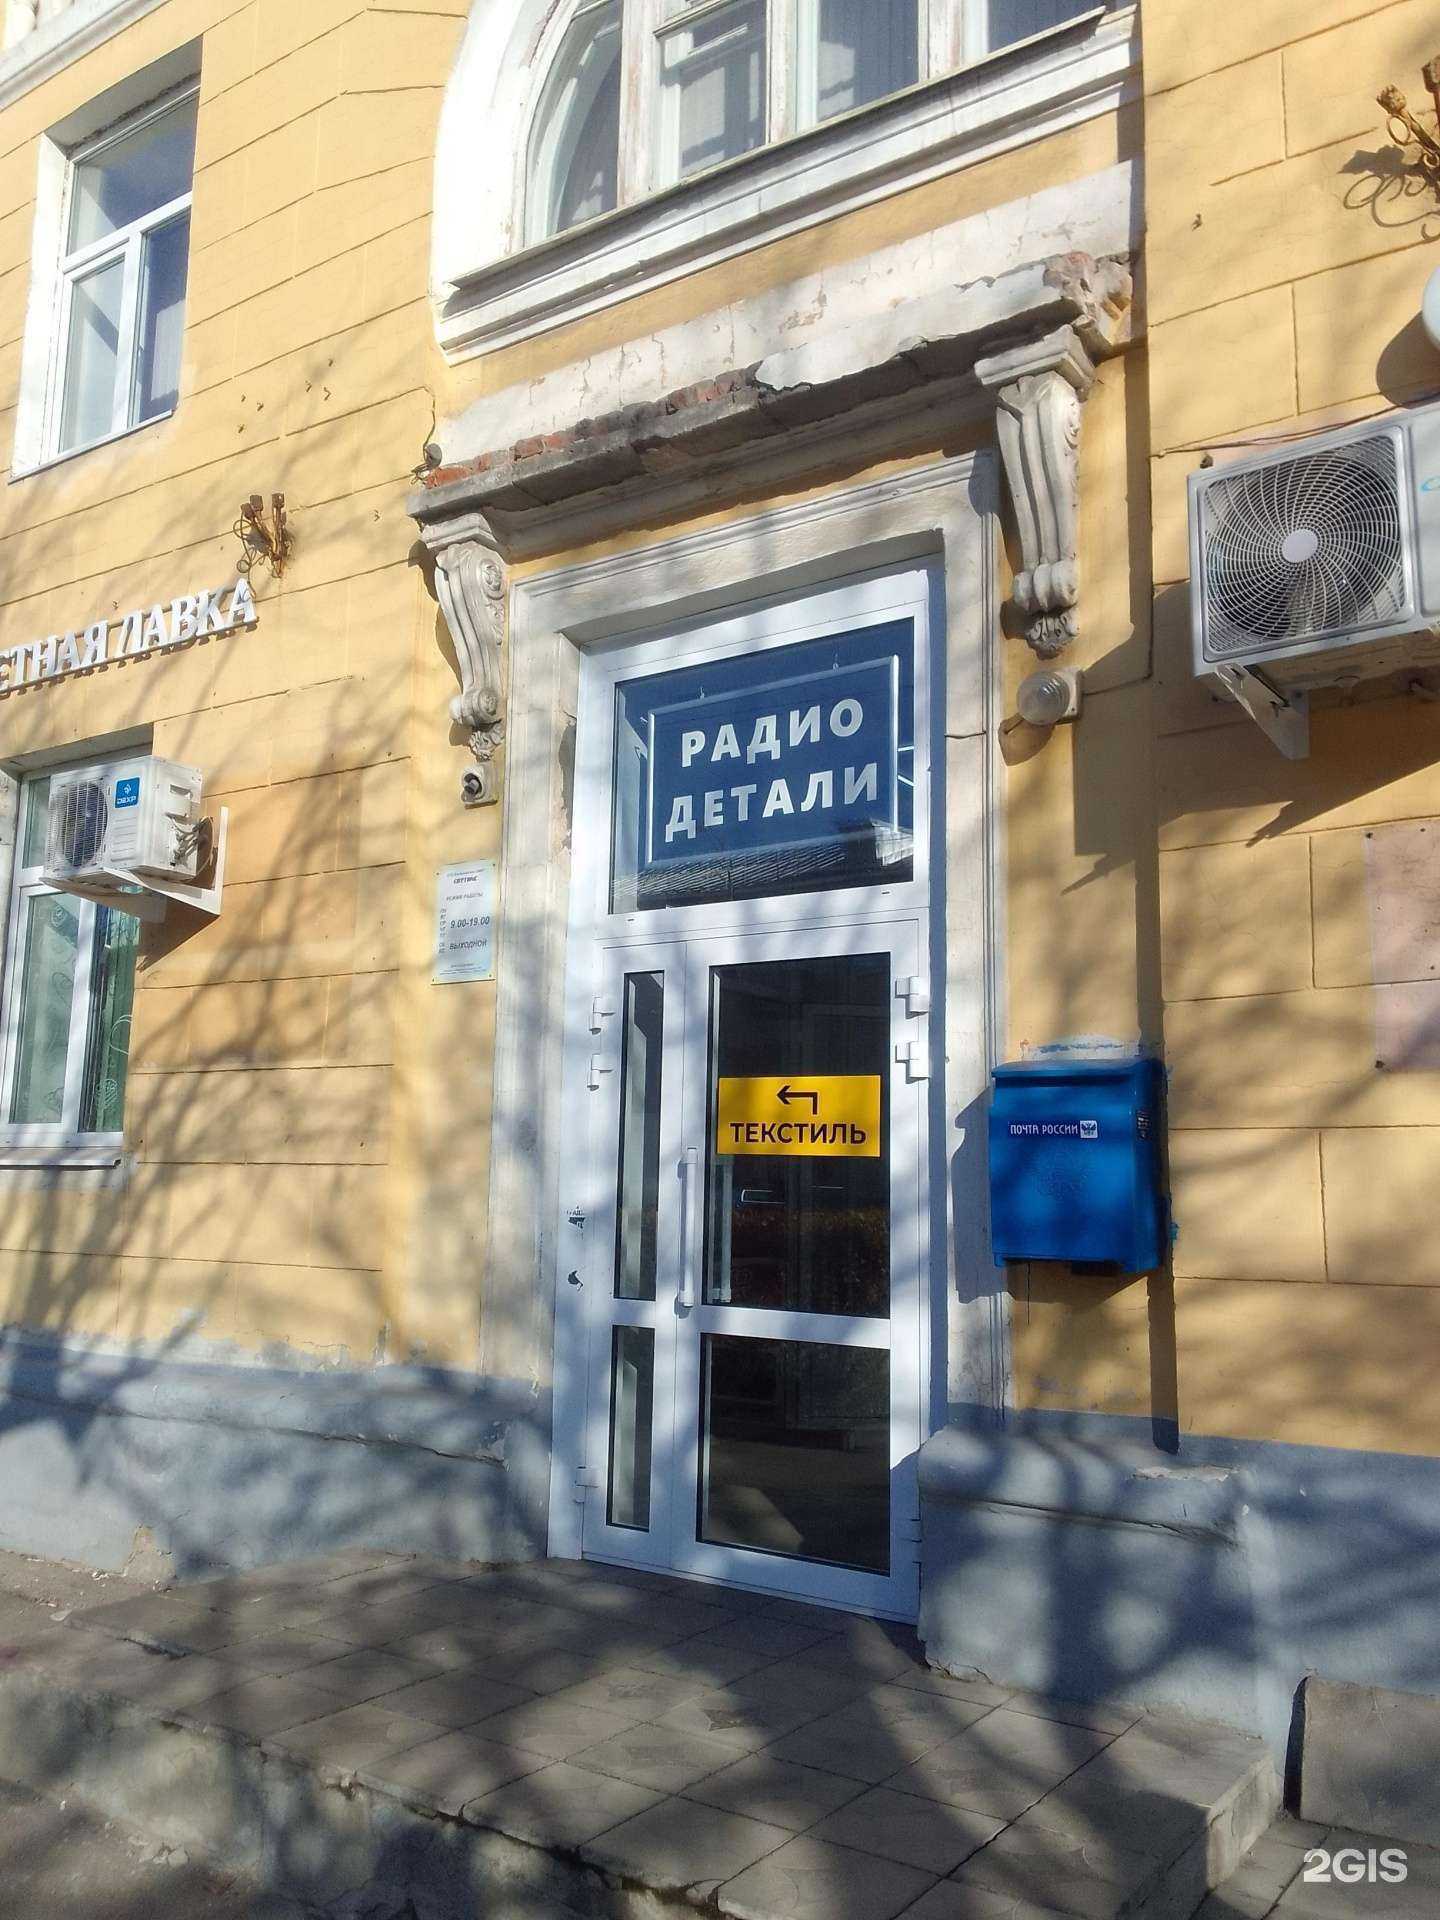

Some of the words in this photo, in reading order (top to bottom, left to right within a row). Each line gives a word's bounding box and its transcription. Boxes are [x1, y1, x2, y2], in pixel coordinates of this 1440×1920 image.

[115, 578, 257, 659] ЛАВКА
[681, 698, 864, 768] РАДИО
[664, 762, 878, 843] ДЕТАЛИ
[450, 916, 490, 929] 9.00-19.00
[730, 1122, 867, 1145] ТЕКСТИЛЬ
[1010, 1124, 1040, 1135] ПОЧТА
[1041, 1124, 1079, 1135] РОССИИ
